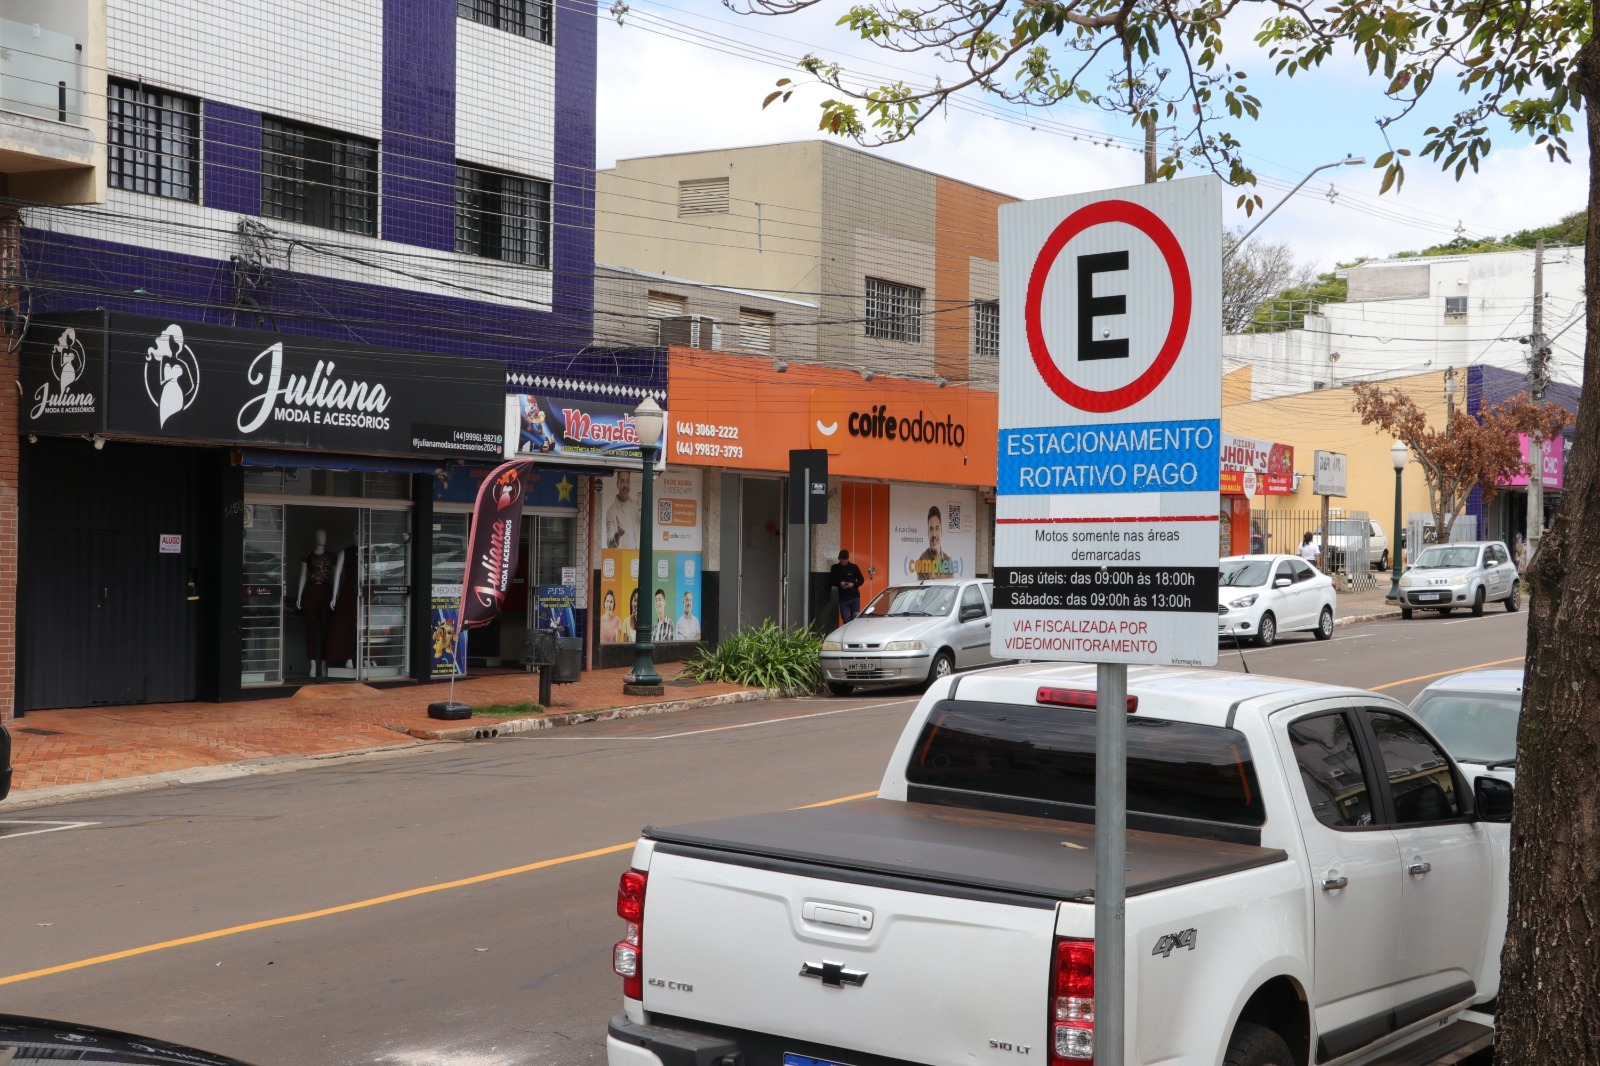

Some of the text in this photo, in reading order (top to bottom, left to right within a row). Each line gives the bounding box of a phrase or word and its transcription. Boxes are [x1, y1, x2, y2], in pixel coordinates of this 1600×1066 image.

[1077, 250, 1129, 362] E
[237, 341, 391, 433] Juliana
[30, 382, 96, 419] Juliana
[274, 407, 390, 430] MODA E ACESSÓRIOS
[848, 405, 965, 447] coife odonto
[676, 421, 739, 439] (44) 3068-2222
[676, 441, 743, 459] (44) 99837-3793
[1007, 426, 1213, 456] ESTACIONAMENTO
[1233, 439, 1256, 450] PIZZARIA
[1220, 445, 1267, 469] JHON'S
[1020, 462, 1198, 488] ROTATIVO PAGO
[162, 536, 180, 545] ALUGO
[502, 519, 512, 563] ACESSÓRIOS
[1035, 528, 1180, 542] Motos somente nas áreas
[1071, 549, 1141, 561] demarcadas
[474, 518, 506, 611] Juliana
[500, 569, 510, 592] MODA
[1009, 571, 1195, 586] Dias úteis: das 09:00h às 18:00h
[547, 587, 565, 595] PS5
[1011, 592, 1191, 608] Sábados: das 09:00h às 13:00h
[1013, 620, 1147, 634] VIA FISCALIZADA POR
[1005, 637, 1158, 653] VIDEOMONITORAMENTO
[1171, 658, 1202, 666] Informações
[989, 1039, 1032, 1054] S10 LT
